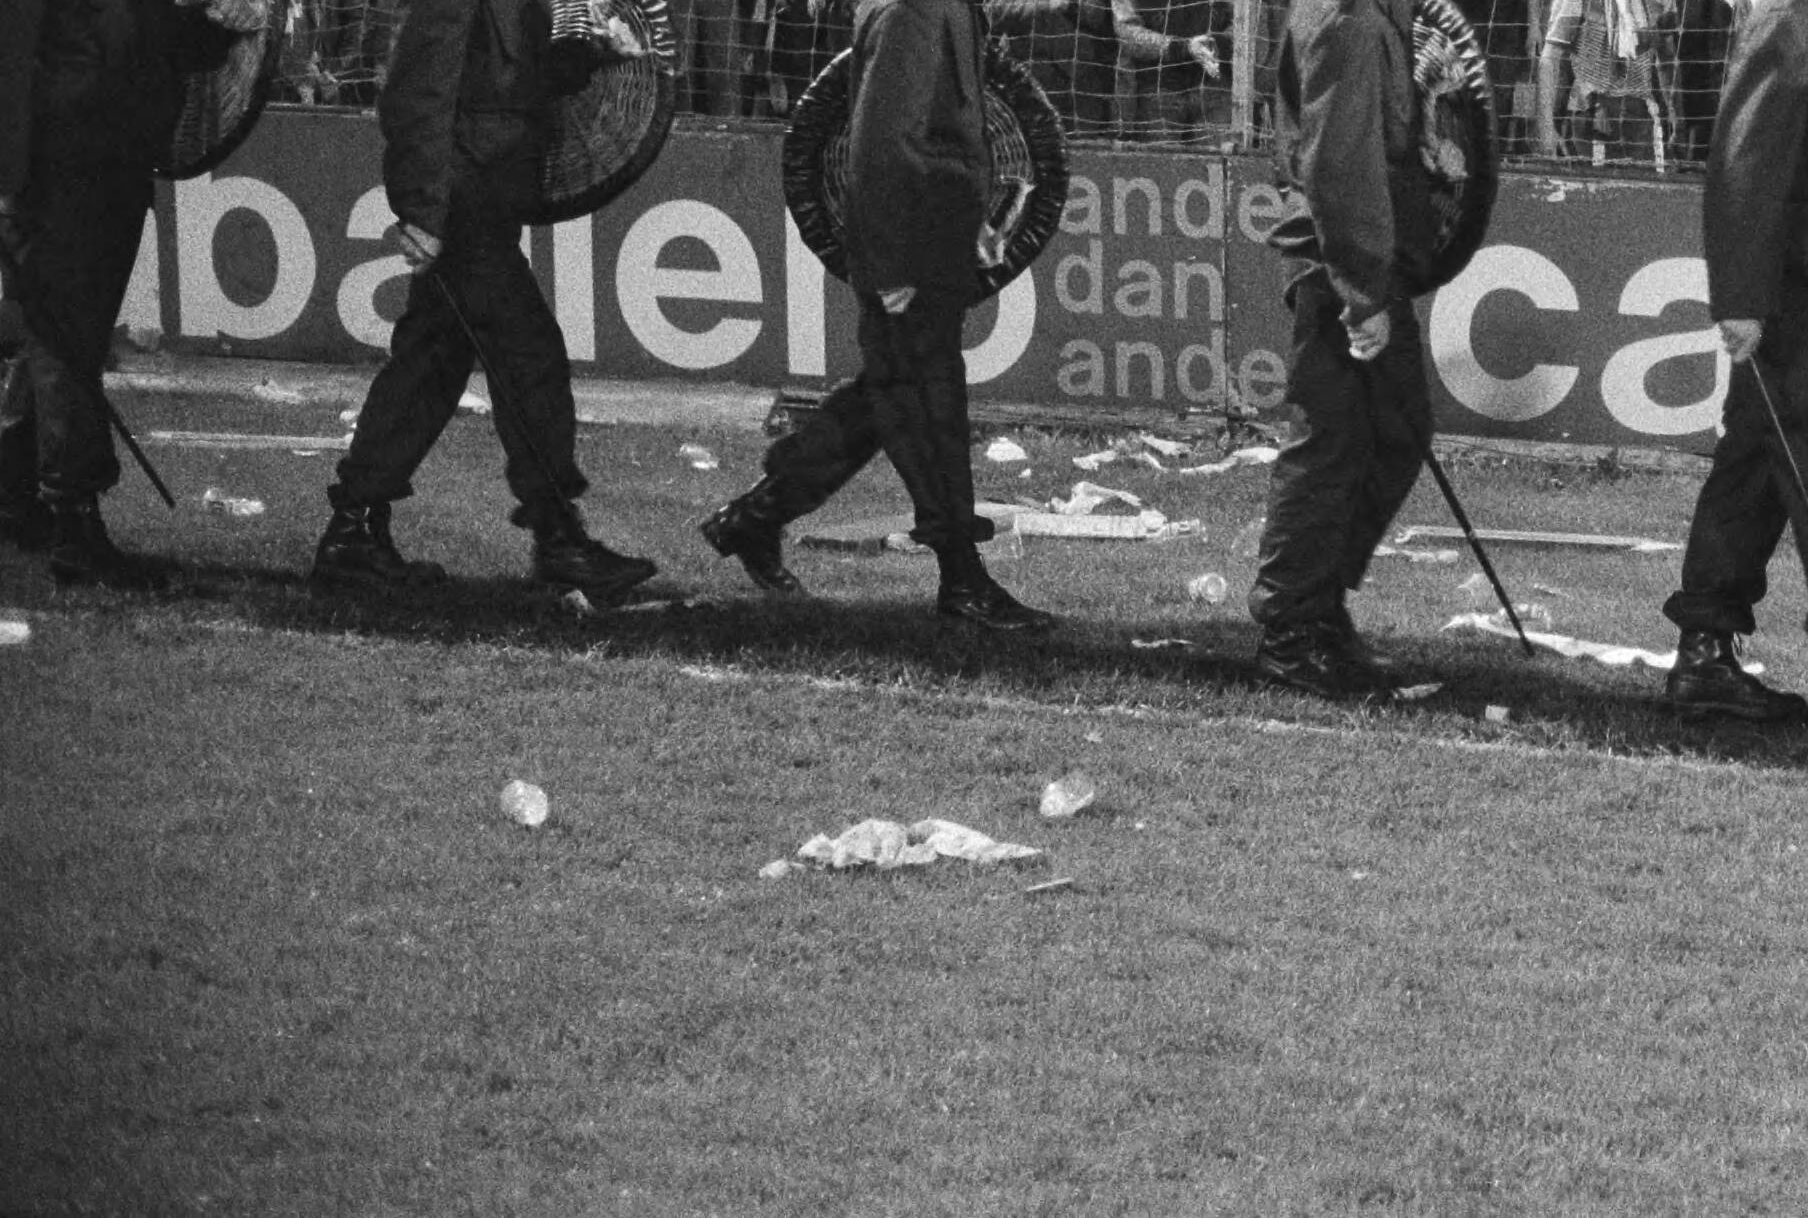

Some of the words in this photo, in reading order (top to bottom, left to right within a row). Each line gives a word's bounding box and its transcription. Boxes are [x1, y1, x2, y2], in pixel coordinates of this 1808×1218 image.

[1058, 163, 1287, 244] ande
[1055, 238, 1223, 321] dan
[1056, 329, 1289, 408] ande
